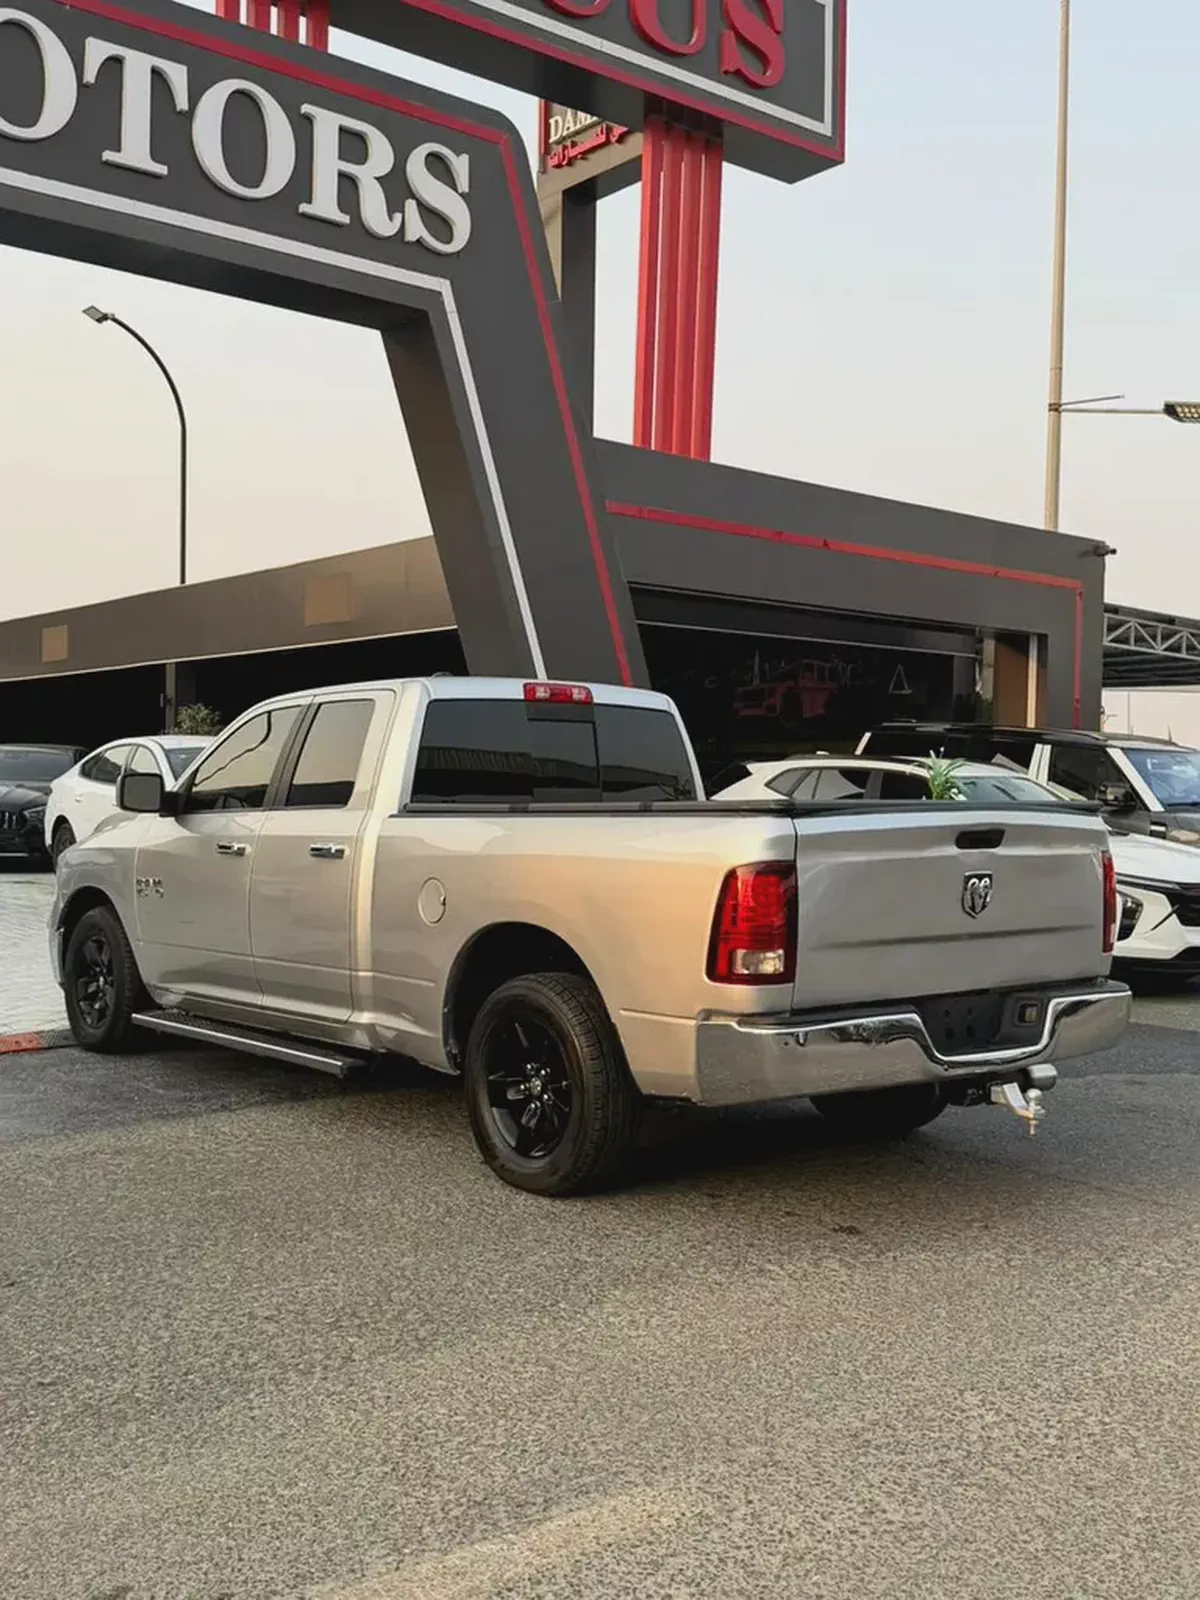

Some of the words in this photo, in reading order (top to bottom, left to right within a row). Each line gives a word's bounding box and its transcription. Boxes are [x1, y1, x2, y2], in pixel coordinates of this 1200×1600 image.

[546, 0, 786, 89] US
[0, 7, 472, 255] OTORS
[548, 108, 601, 143] DAM
